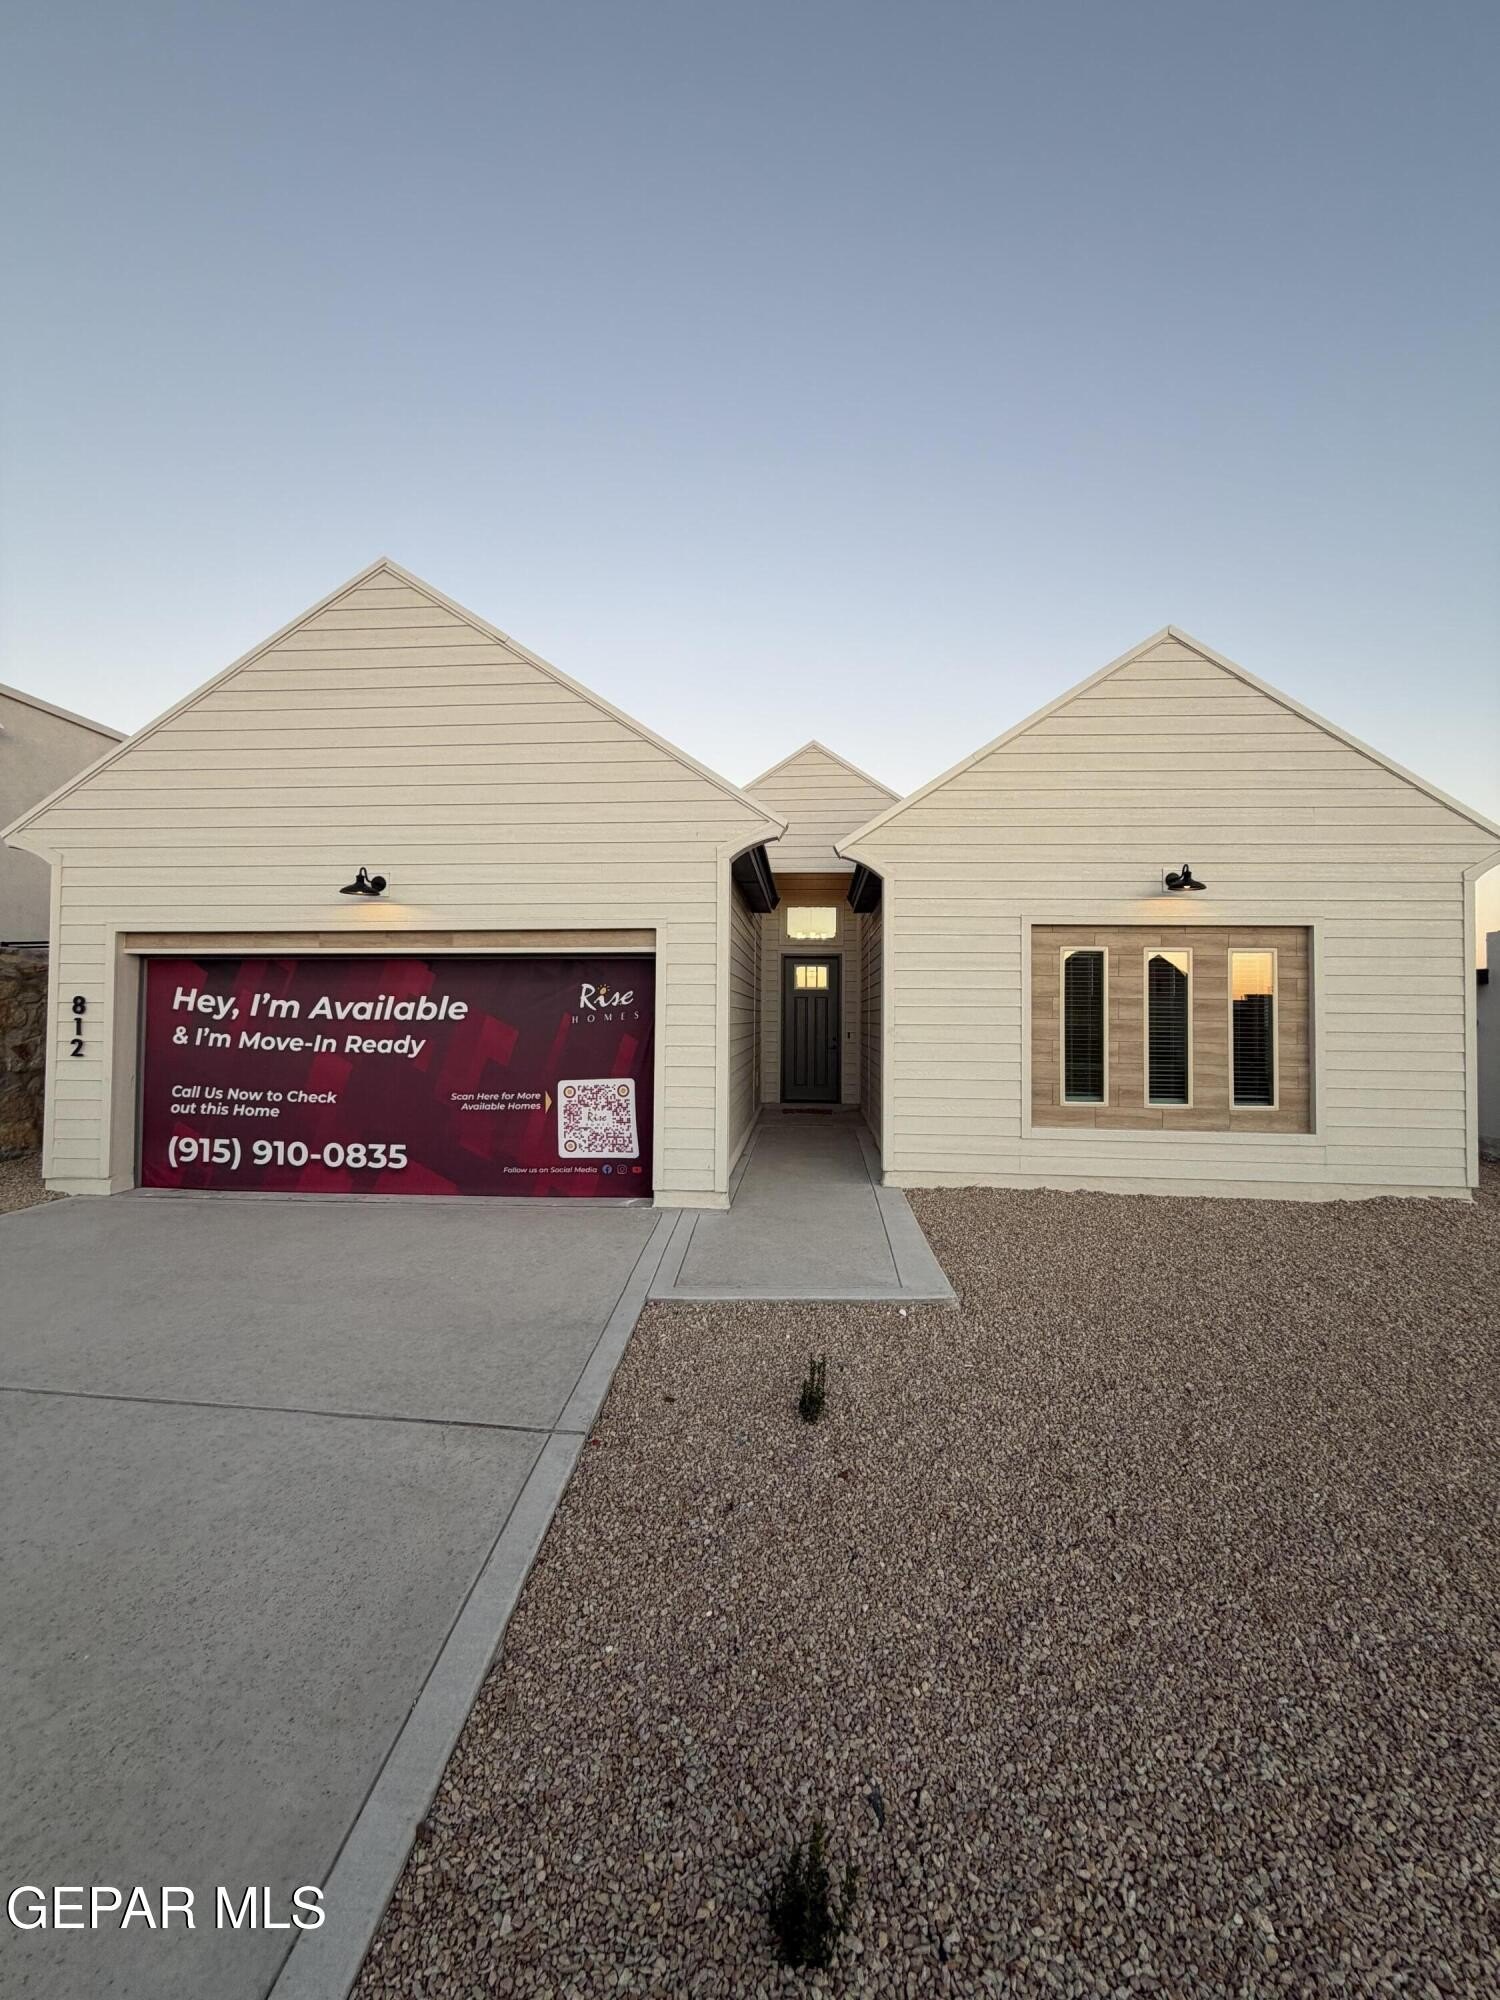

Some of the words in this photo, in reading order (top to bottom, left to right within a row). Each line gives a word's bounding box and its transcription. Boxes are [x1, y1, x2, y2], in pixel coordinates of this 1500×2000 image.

[173, 987, 239, 1020] Hey,
[250, 993, 300, 1018] I'm
[308, 995, 468, 1020] Available
[580, 984, 633, 1010] Rise
[572, 1012, 638, 1023] HOMES
[173, 1026, 188, 1044] &
[195, 1028, 231, 1047] I'm
[239, 1032, 336, 1052] Move-In
[345, 1035, 425, 1058] Ready
[172, 1085, 201, 1098] Call
[205, 1087, 223, 1100] Us
[227, 1088, 263, 1101] Now
[267, 1090, 282, 1101] to
[287, 1091, 337, 1104] Check
[477, 1093, 499, 1101] Here
[502, 1092, 515, 1100] for
[171, 1103, 196, 1114] out
[200, 1102, 229, 1115] this
[233, 1104, 280, 1117] Home
[461, 1102, 505, 1110] Available
[169, 1136, 241, 1169] (915)
[253, 1140, 407, 1168] 910-0835
